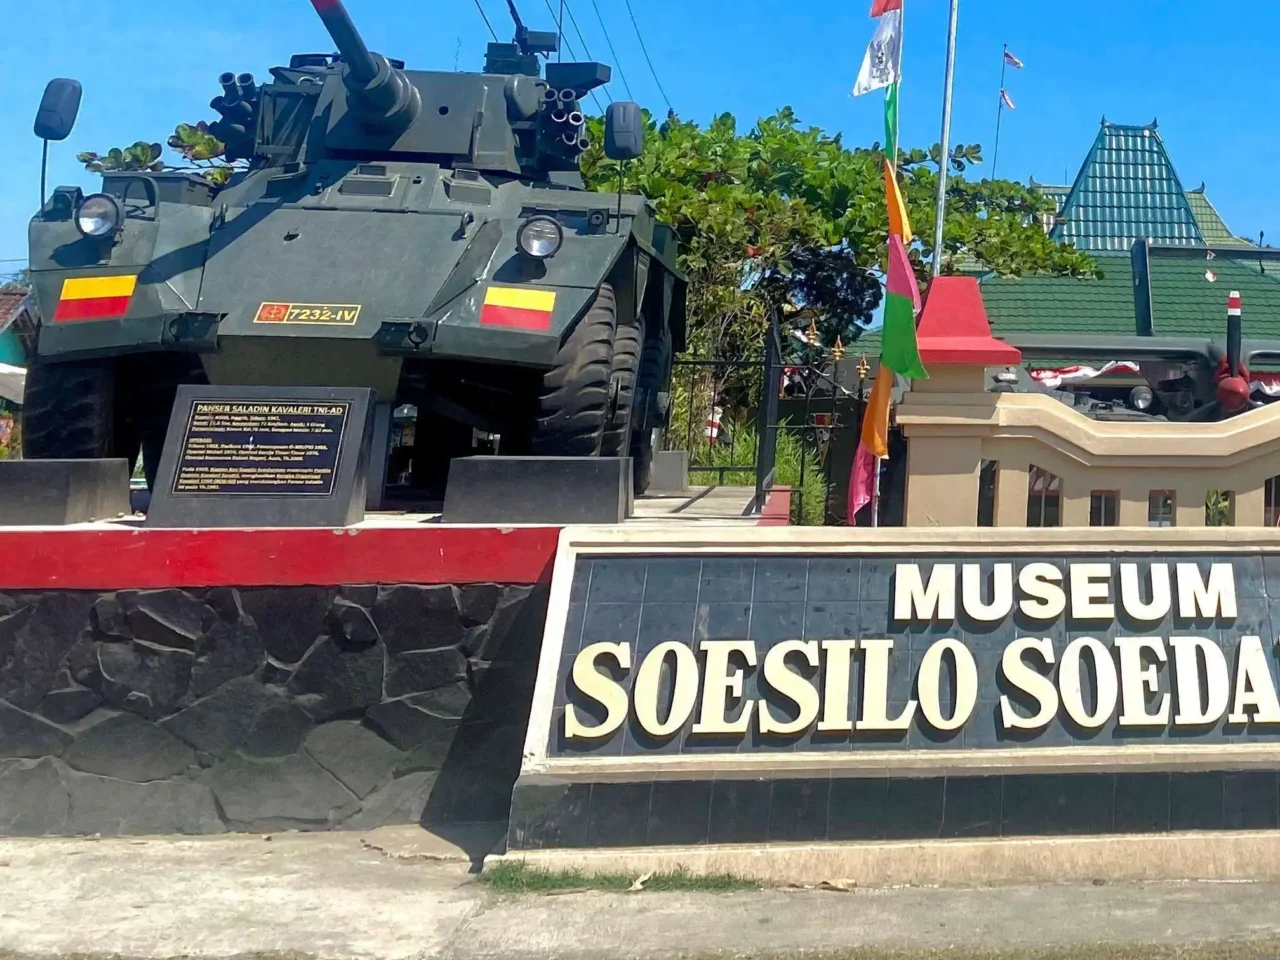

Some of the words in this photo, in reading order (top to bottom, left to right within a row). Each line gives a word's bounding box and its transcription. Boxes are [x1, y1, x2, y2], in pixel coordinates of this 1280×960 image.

[289, 309, 356, 321] 7232-IV
[196, 405, 230, 413] PANSER
[271, 406, 311, 414] KAVALERI
[893, 561, 1239, 622] MUSEUM
[563, 637, 980, 739] SOESILO
